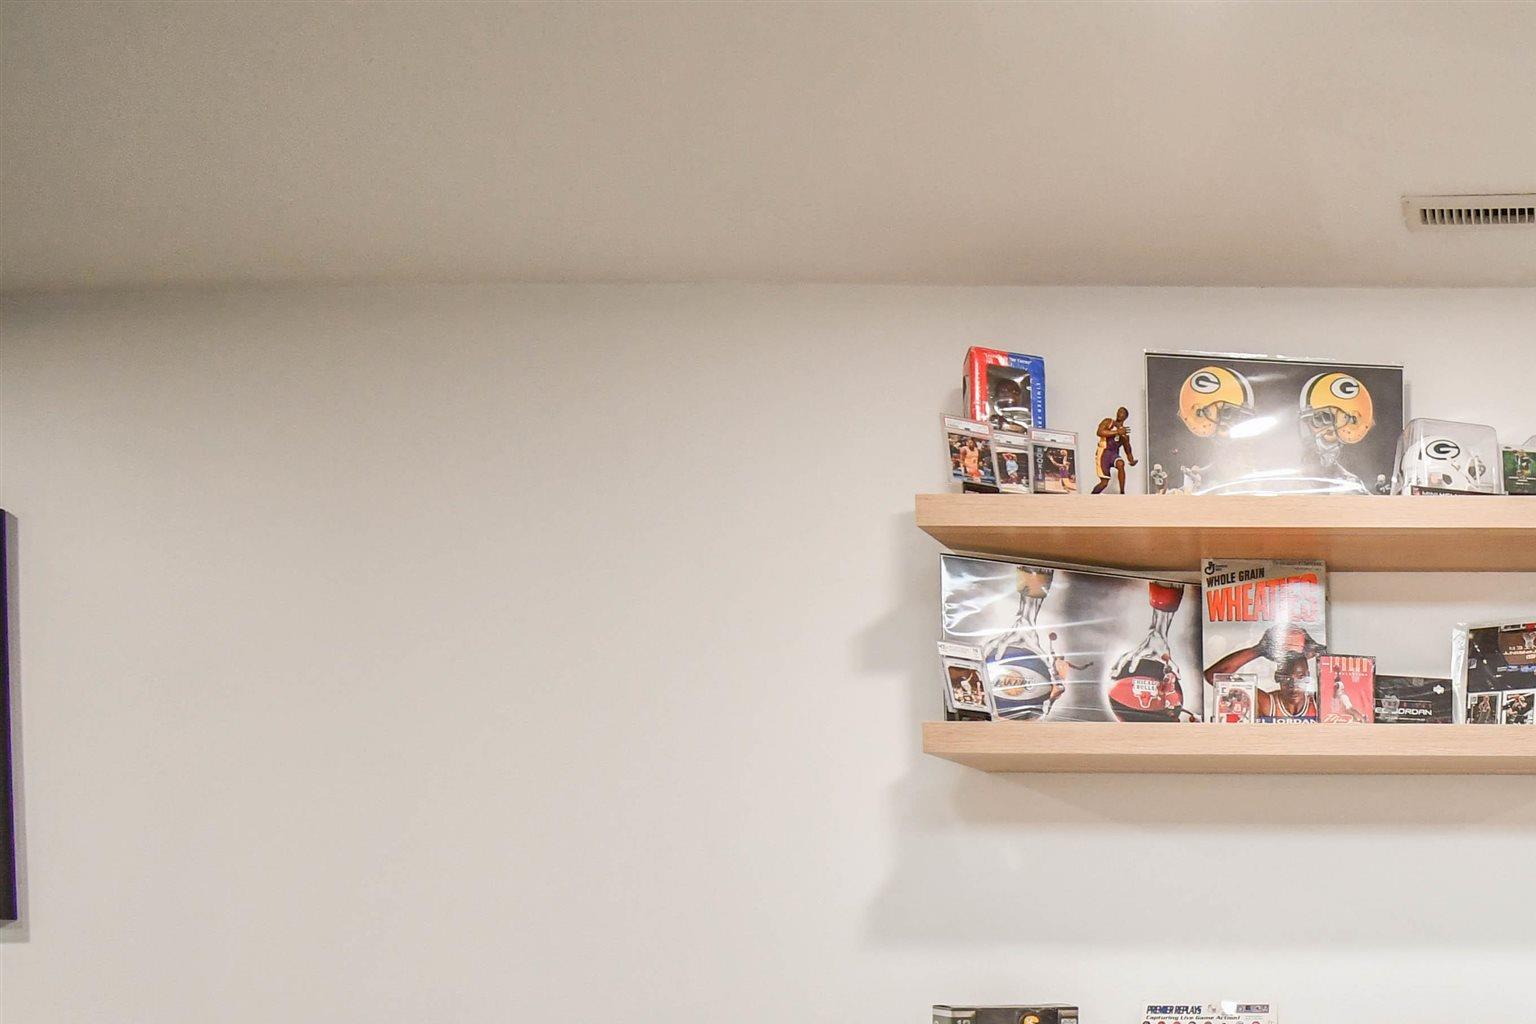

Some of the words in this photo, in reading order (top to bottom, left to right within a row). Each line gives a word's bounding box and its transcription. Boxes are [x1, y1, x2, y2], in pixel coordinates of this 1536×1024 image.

[1206, 572, 1236, 588] WHOLE
[1238, 567, 1265, 581] GRAIN
[1206, 573, 1318, 623] WHEATS
[1391, 706, 1433, 716] JORDAN
[1146, 1005, 1174, 1014] PREMIER
[1174, 1005, 1202, 1014] REPLAYS
